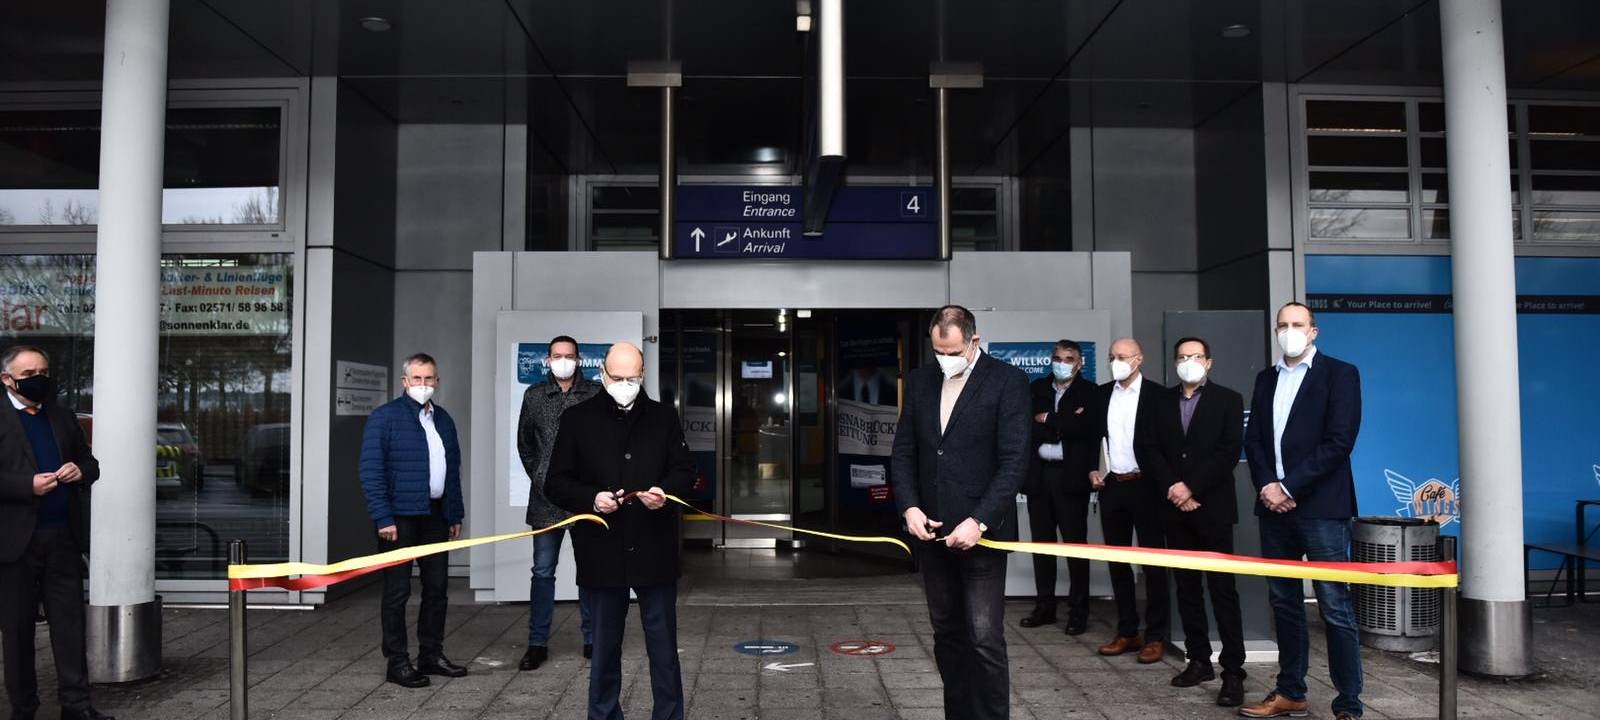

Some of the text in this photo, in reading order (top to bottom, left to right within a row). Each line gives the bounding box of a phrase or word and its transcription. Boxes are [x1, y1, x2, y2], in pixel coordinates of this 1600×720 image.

[743, 190, 791, 205] Eingang
[906, 195, 921, 213] 4
[743, 205, 796, 217] Entrance
[743, 227, 791, 239] Ankunft
[743, 241, 785, 253] Arrival
[204, 272, 213, 283] &
[235, 286, 275, 296] Reisen
[175, 303, 198, 313] Fax:
[1347, 301, 1432, 309] Your Place to arrive!
[1420, 484, 1446, 502] Café
